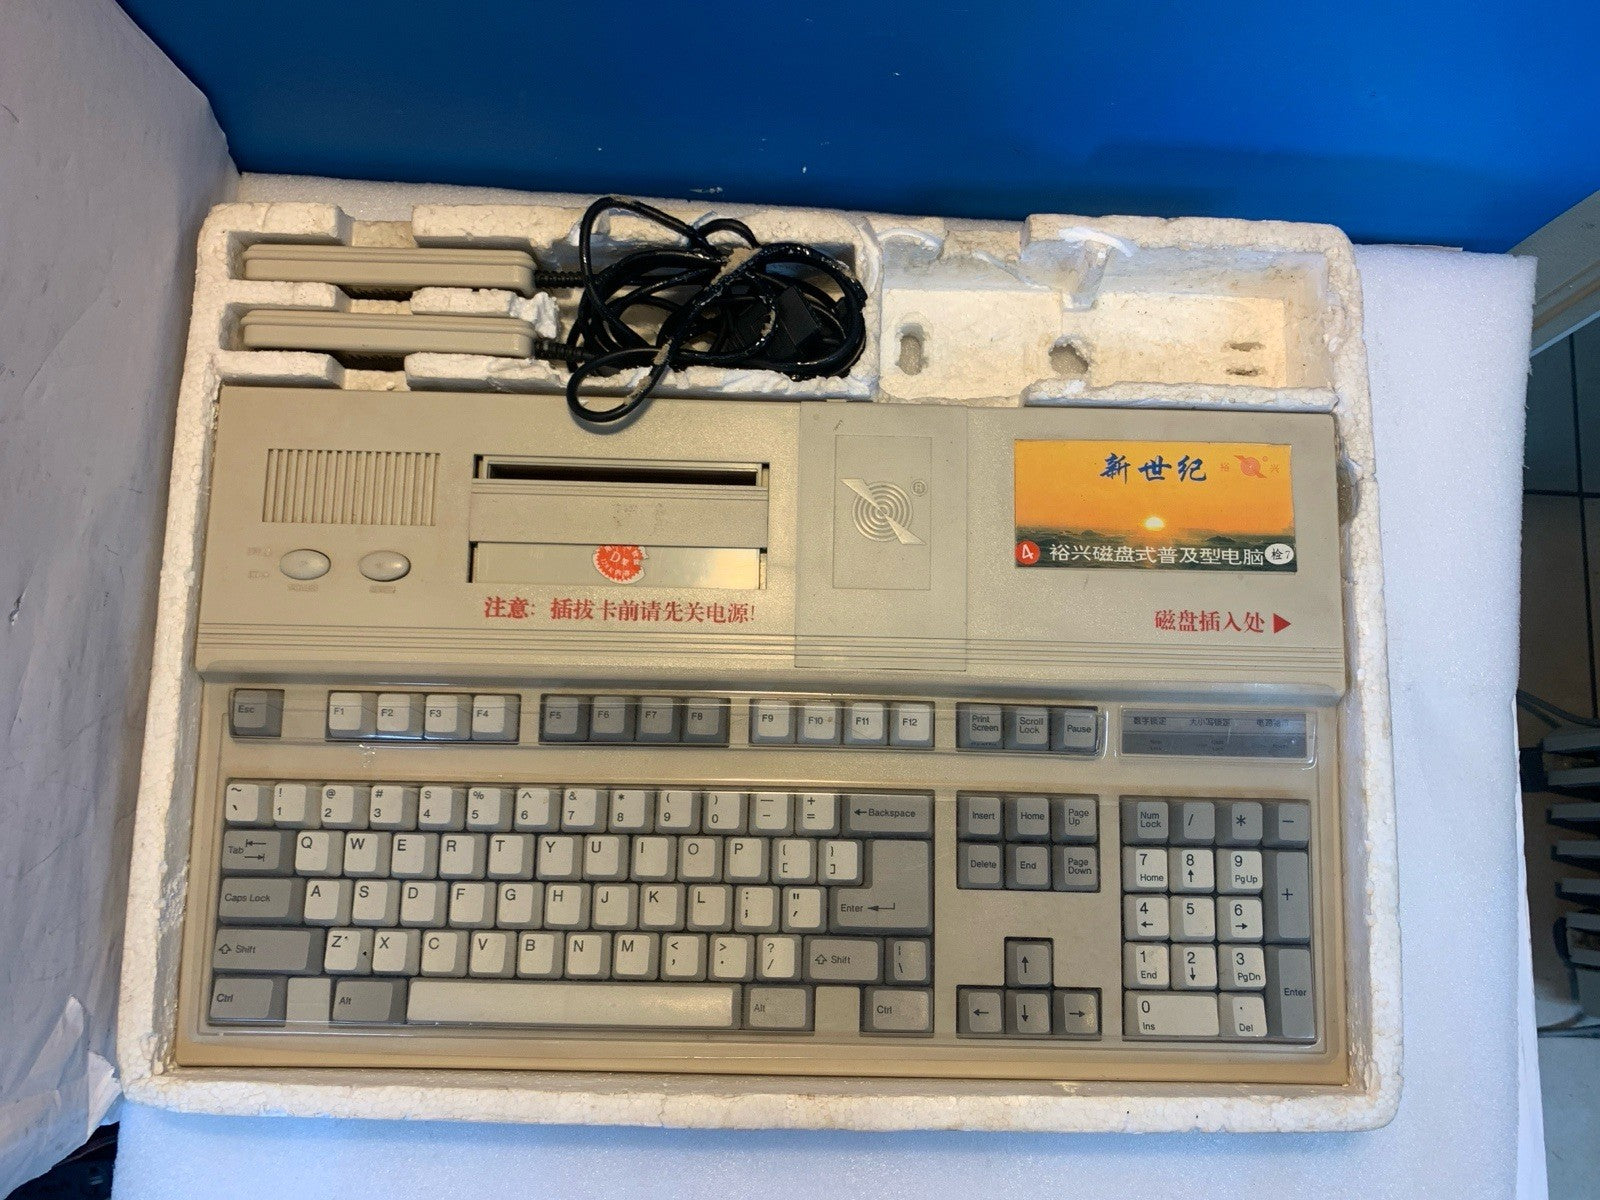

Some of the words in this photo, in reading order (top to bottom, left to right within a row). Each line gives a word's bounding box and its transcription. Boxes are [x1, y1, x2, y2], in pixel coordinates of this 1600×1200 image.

[1100, 452, 1207, 484] 新世纪
[1050, 543, 1264, 566] 裕兴磁盘式普及型电脑
[1154, 609, 1265, 633] 磁盘插入处
[237, 705, 255, 714] Esc
[333, 707, 345, 716] F1
[381, 708, 394, 717] F2
[429, 709, 442, 718] F3
[476, 709, 490, 718] F4
[597, 710, 610, 719] F6
[645, 710, 658, 719] F7
[549, 711, 562, 720] F5
[691, 712, 703, 721] F8
[761, 714, 774, 723] F9
[808, 716, 824, 725] F10
[971, 715, 991, 724] Print
[855, 717, 870, 725] F11
[902, 718, 918, 726] F12
[1019, 716, 1044, 726] Scroll
[971, 723, 999, 732] Screen
[1019, 726, 1041, 734] Lock
[1066, 724, 1092, 734] Pause
[324, 808, 332, 818] 2
[373, 808, 381, 818] 3
[423, 809, 431, 819] 4
[471, 809, 479, 820] 5
[520, 810, 528, 820] 6
[567, 810, 575, 820] 7
[616, 812, 624, 822] 8
[663, 812, 671, 822] 9
[868, 808, 916, 818] Backspace
[972, 811, 995, 820] Insert
[1020, 811, 1045, 820] Home
[1068, 808, 1090, 818] Page
[1140, 811, 1160, 820] Num
[711, 813, 719, 824] 0
[1068, 817, 1081, 827] Up
[1140, 820, 1162, 828] Lock
[300, 836, 313, 849] Q
[350, 837, 365, 850] W
[397, 839, 407, 851] E
[446, 839, 457, 852] R
[495, 839, 506, 852] T
[545, 841, 556, 853] Y
[591, 841, 602, 854] U
[227, 845, 245, 854] Tab
[687, 842, 699, 855] O
[734, 842, 744, 855] P
[970, 859, 997, 869] Delete
[1067, 857, 1089, 867] Page
[1139, 853, 1148, 866] 7
[1185, 853, 1195, 867] 8
[1234, 854, 1243, 868] 9
[1020, 861, 1037, 870] End
[1067, 866, 1093, 875] Down
[1139, 873, 1165, 883] Home
[1234, 875, 1258, 885] PgUp
[310, 885, 322, 898] A
[358, 885, 370, 898] S
[407, 886, 419, 899] D
[456, 888, 466, 900] F
[504, 888, 516, 901] G
[552, 889, 564, 902] H
[224, 893, 248, 904] Caps
[249, 893, 271, 902] Lock
[600, 891, 609, 904] J
[649, 891, 660, 903] K
[697, 891, 706, 903] L
[840, 903, 864, 913] Enter
[1139, 902, 1149, 915] 4
[1186, 902, 1195, 915] 5
[1234, 903, 1243, 917] 6
[331, 935, 342, 948] Z
[379, 937, 391, 949] X
[428, 937, 440, 950] C
[477, 938, 489, 950] V
[525, 939, 536, 952] B
[573, 940, 585, 952] N
[621, 940, 634, 952] M
[235, 944, 256, 954] Shift
[830, 954, 851, 964] Shift
[1187, 951, 1196, 964] 2
[1235, 952, 1245, 966] 3
[1140, 971, 1158, 980] End
[1237, 972, 1261, 982] PgDn
[1284, 987, 1307, 997] Enter
[216, 993, 234, 1003] Ctrl
[338, 996, 352, 1005] Alt
[753, 1003, 766, 1013] Alt
[876, 1005, 893, 1014] Ctrl
[1141, 1000, 1151, 1014] 0
[1142, 1022, 1156, 1031] Ins
[1238, 1023, 1254, 1032] Del
